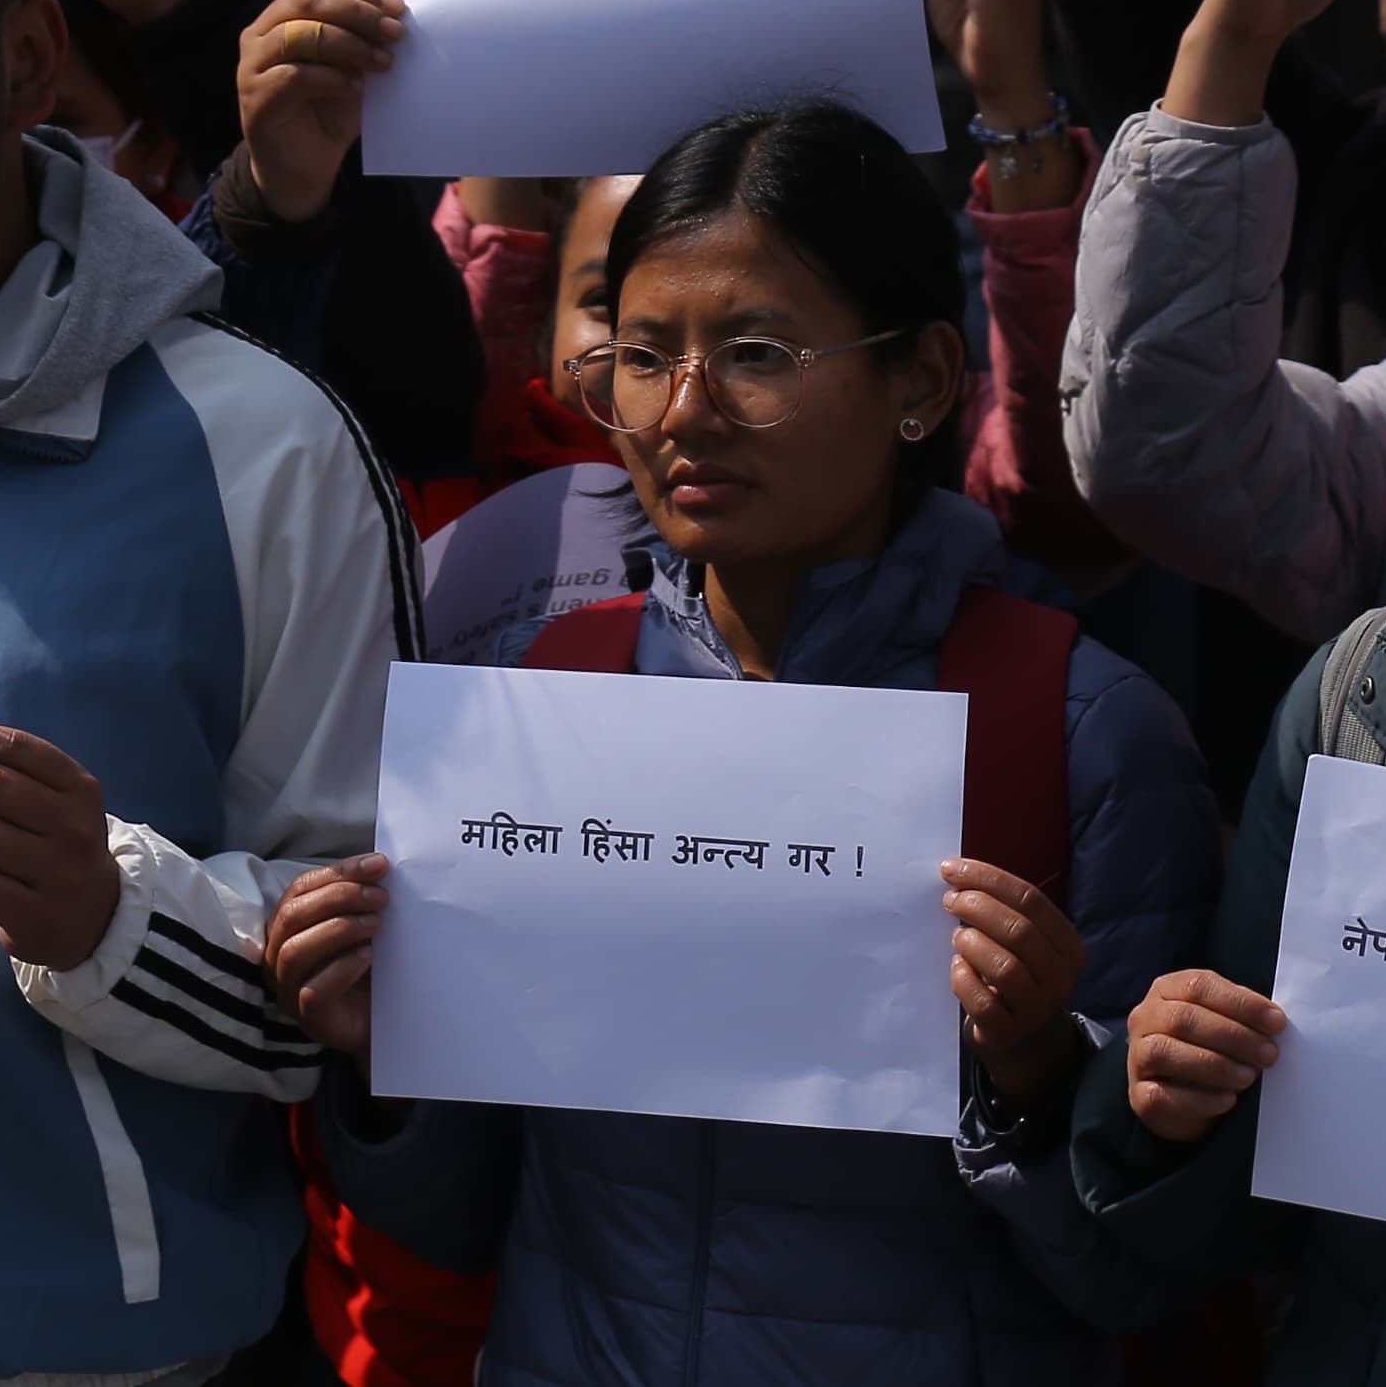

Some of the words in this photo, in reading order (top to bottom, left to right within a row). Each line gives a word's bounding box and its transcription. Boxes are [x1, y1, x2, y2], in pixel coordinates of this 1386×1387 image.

[461, 811, 564, 857] महिला
[580, 818, 656, 864] हिंसा
[671, 835, 770, 870] अन्त्य
[787, 843, 836, 877] गर
[855, 845, 864, 878] !
